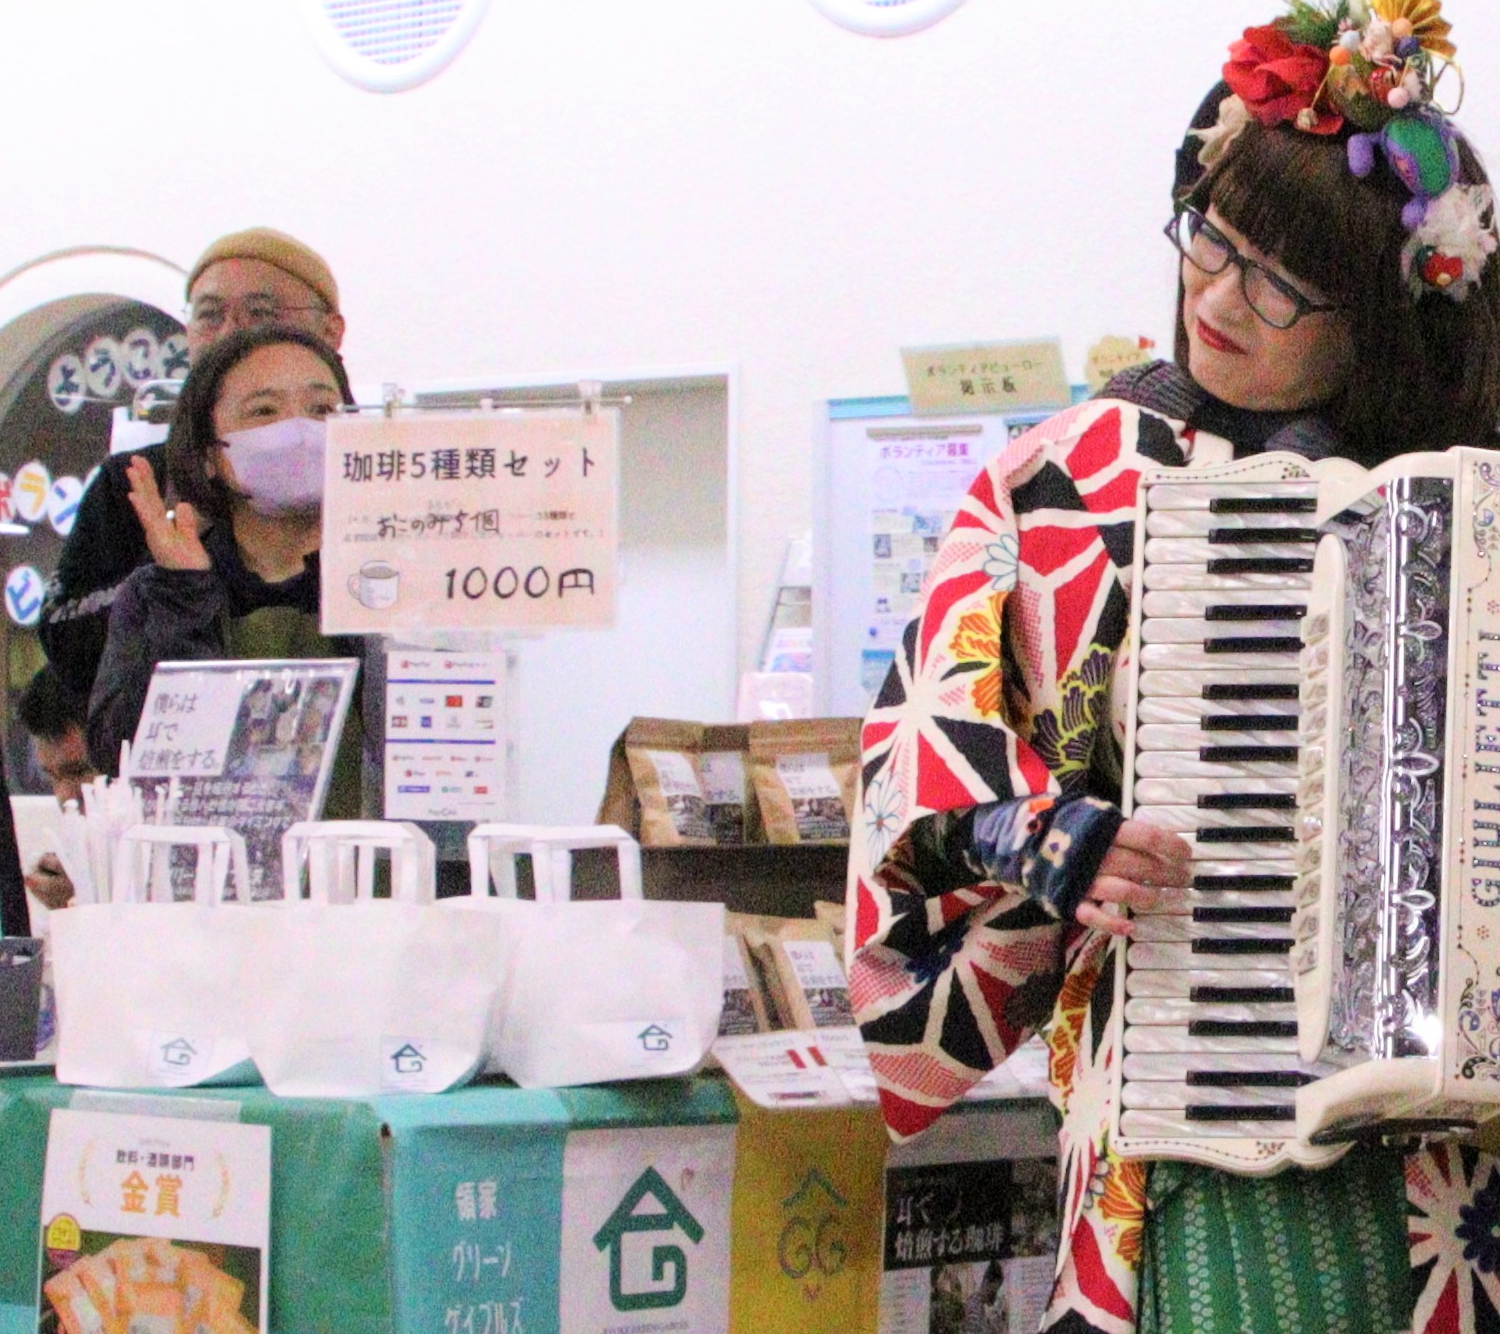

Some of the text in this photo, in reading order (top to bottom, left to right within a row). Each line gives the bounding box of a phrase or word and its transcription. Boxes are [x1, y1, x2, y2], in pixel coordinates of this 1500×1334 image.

[343, 445, 596, 483] 珈琲5種類セット
[445, 565, 596, 601] 1000円
[120, 1169, 184, 1218] 金賞
[451, 1238, 512, 1282] グリーン
